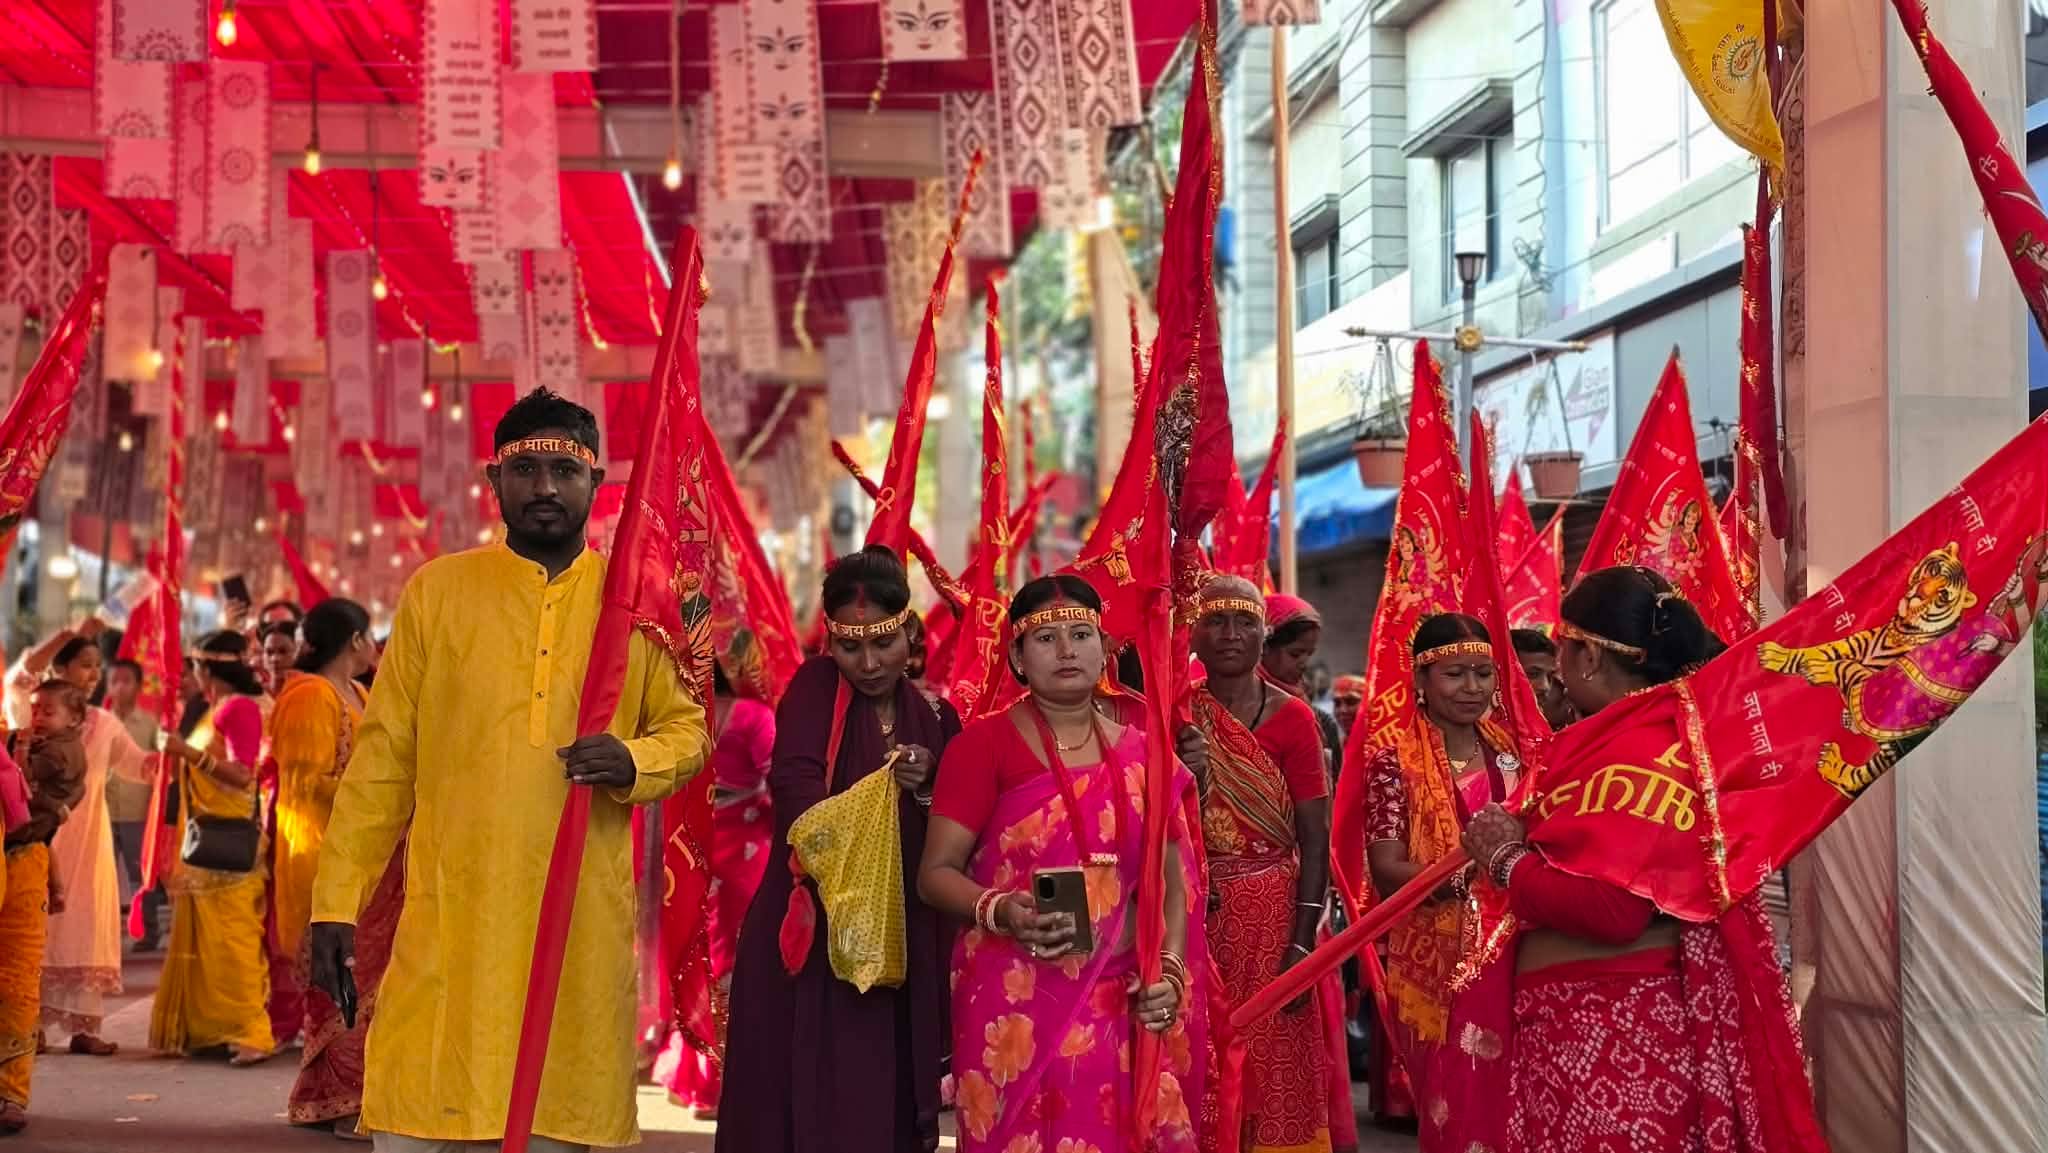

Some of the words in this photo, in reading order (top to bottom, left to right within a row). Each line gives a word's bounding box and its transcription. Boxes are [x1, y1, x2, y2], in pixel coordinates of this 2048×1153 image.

[503, 441, 520, 456] जय
[524, 438, 560, 452] माता
[1960, 496, 1985, 533] माता
[1976, 534, 1998, 556] दी
[1207, 600, 1225, 609] जय
[1031, 609, 1053, 625] जय
[1056, 607, 1088, 620] माता
[1833, 610, 1856, 633] दी
[869, 617, 897, 635] माता
[1438, 643, 1458, 656] जय
[1463, 641, 1488, 654] माता
[1742, 690, 1762, 721] जय
[1749, 720, 1773, 756] माता
[1759, 760, 1783, 780] दी
